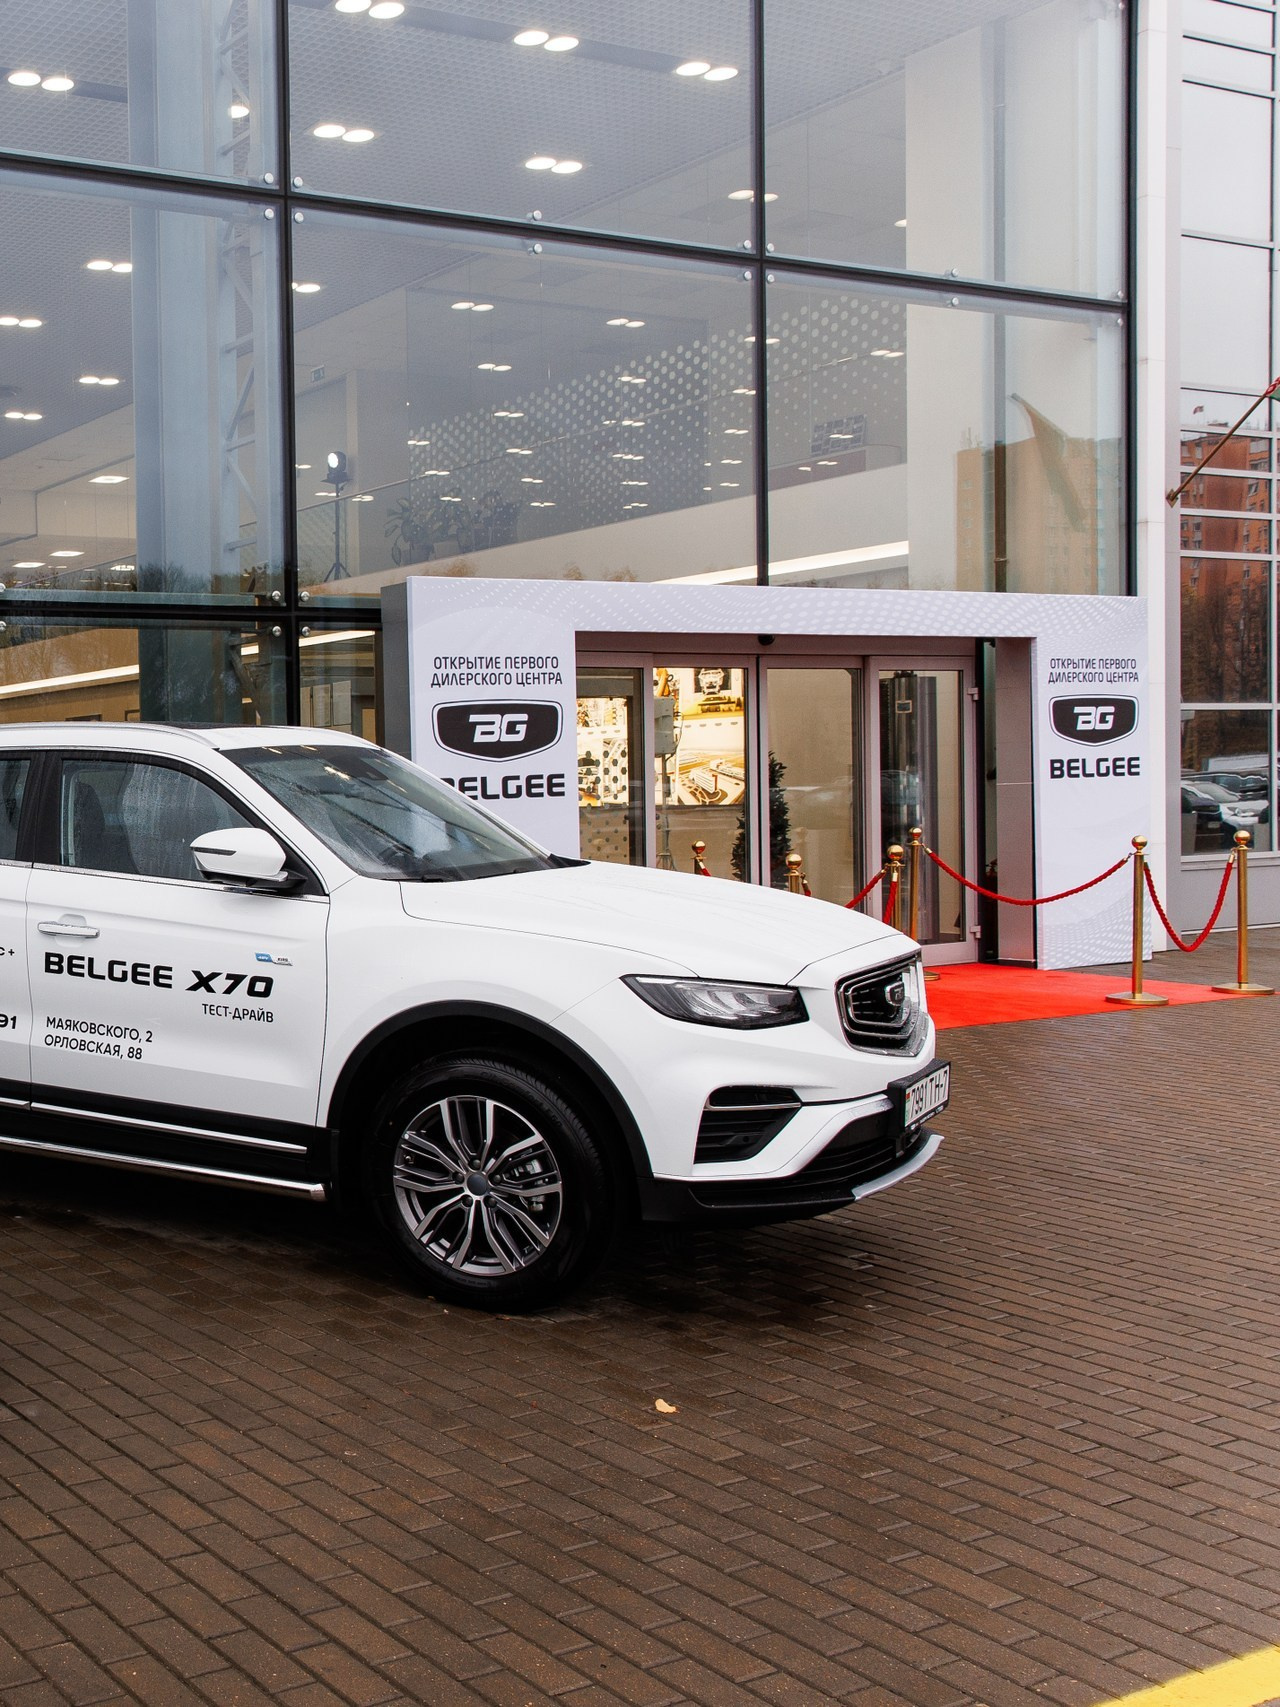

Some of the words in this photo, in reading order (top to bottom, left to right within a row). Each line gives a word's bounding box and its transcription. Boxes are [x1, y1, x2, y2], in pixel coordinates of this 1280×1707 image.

[433, 656, 501, 670] ОТКРЫТИЕ
[504, 656, 559, 669] ПЕРВОГО
[1050, 658, 1096, 670] ОТКРЫТИЕ
[1098, 658, 1136, 670] ПЕРВОГО
[430, 672, 513, 688] ДИЛЕРСКОГО
[515, 671, 563, 687] ЦЕНТРА
[1048, 671, 1104, 685] ДИЛЕРСКОГО
[1106, 671, 1139, 684] ЦЕНТРА
[1049, 756, 1141, 779] BELGEE
[44, 951, 174, 989] BELGEE
[184, 969, 275, 998] X70
[201, 1003, 275, 1023] ТЕСТ-ДРАЙВ
[45, 1016, 142, 1044] МАЯКОВСКОГО,
[144, 1030, 153, 1043] 2
[43, 1034, 125, 1059] ОРЛОВСКАЯ,
[127, 1046, 143, 1060] 88
